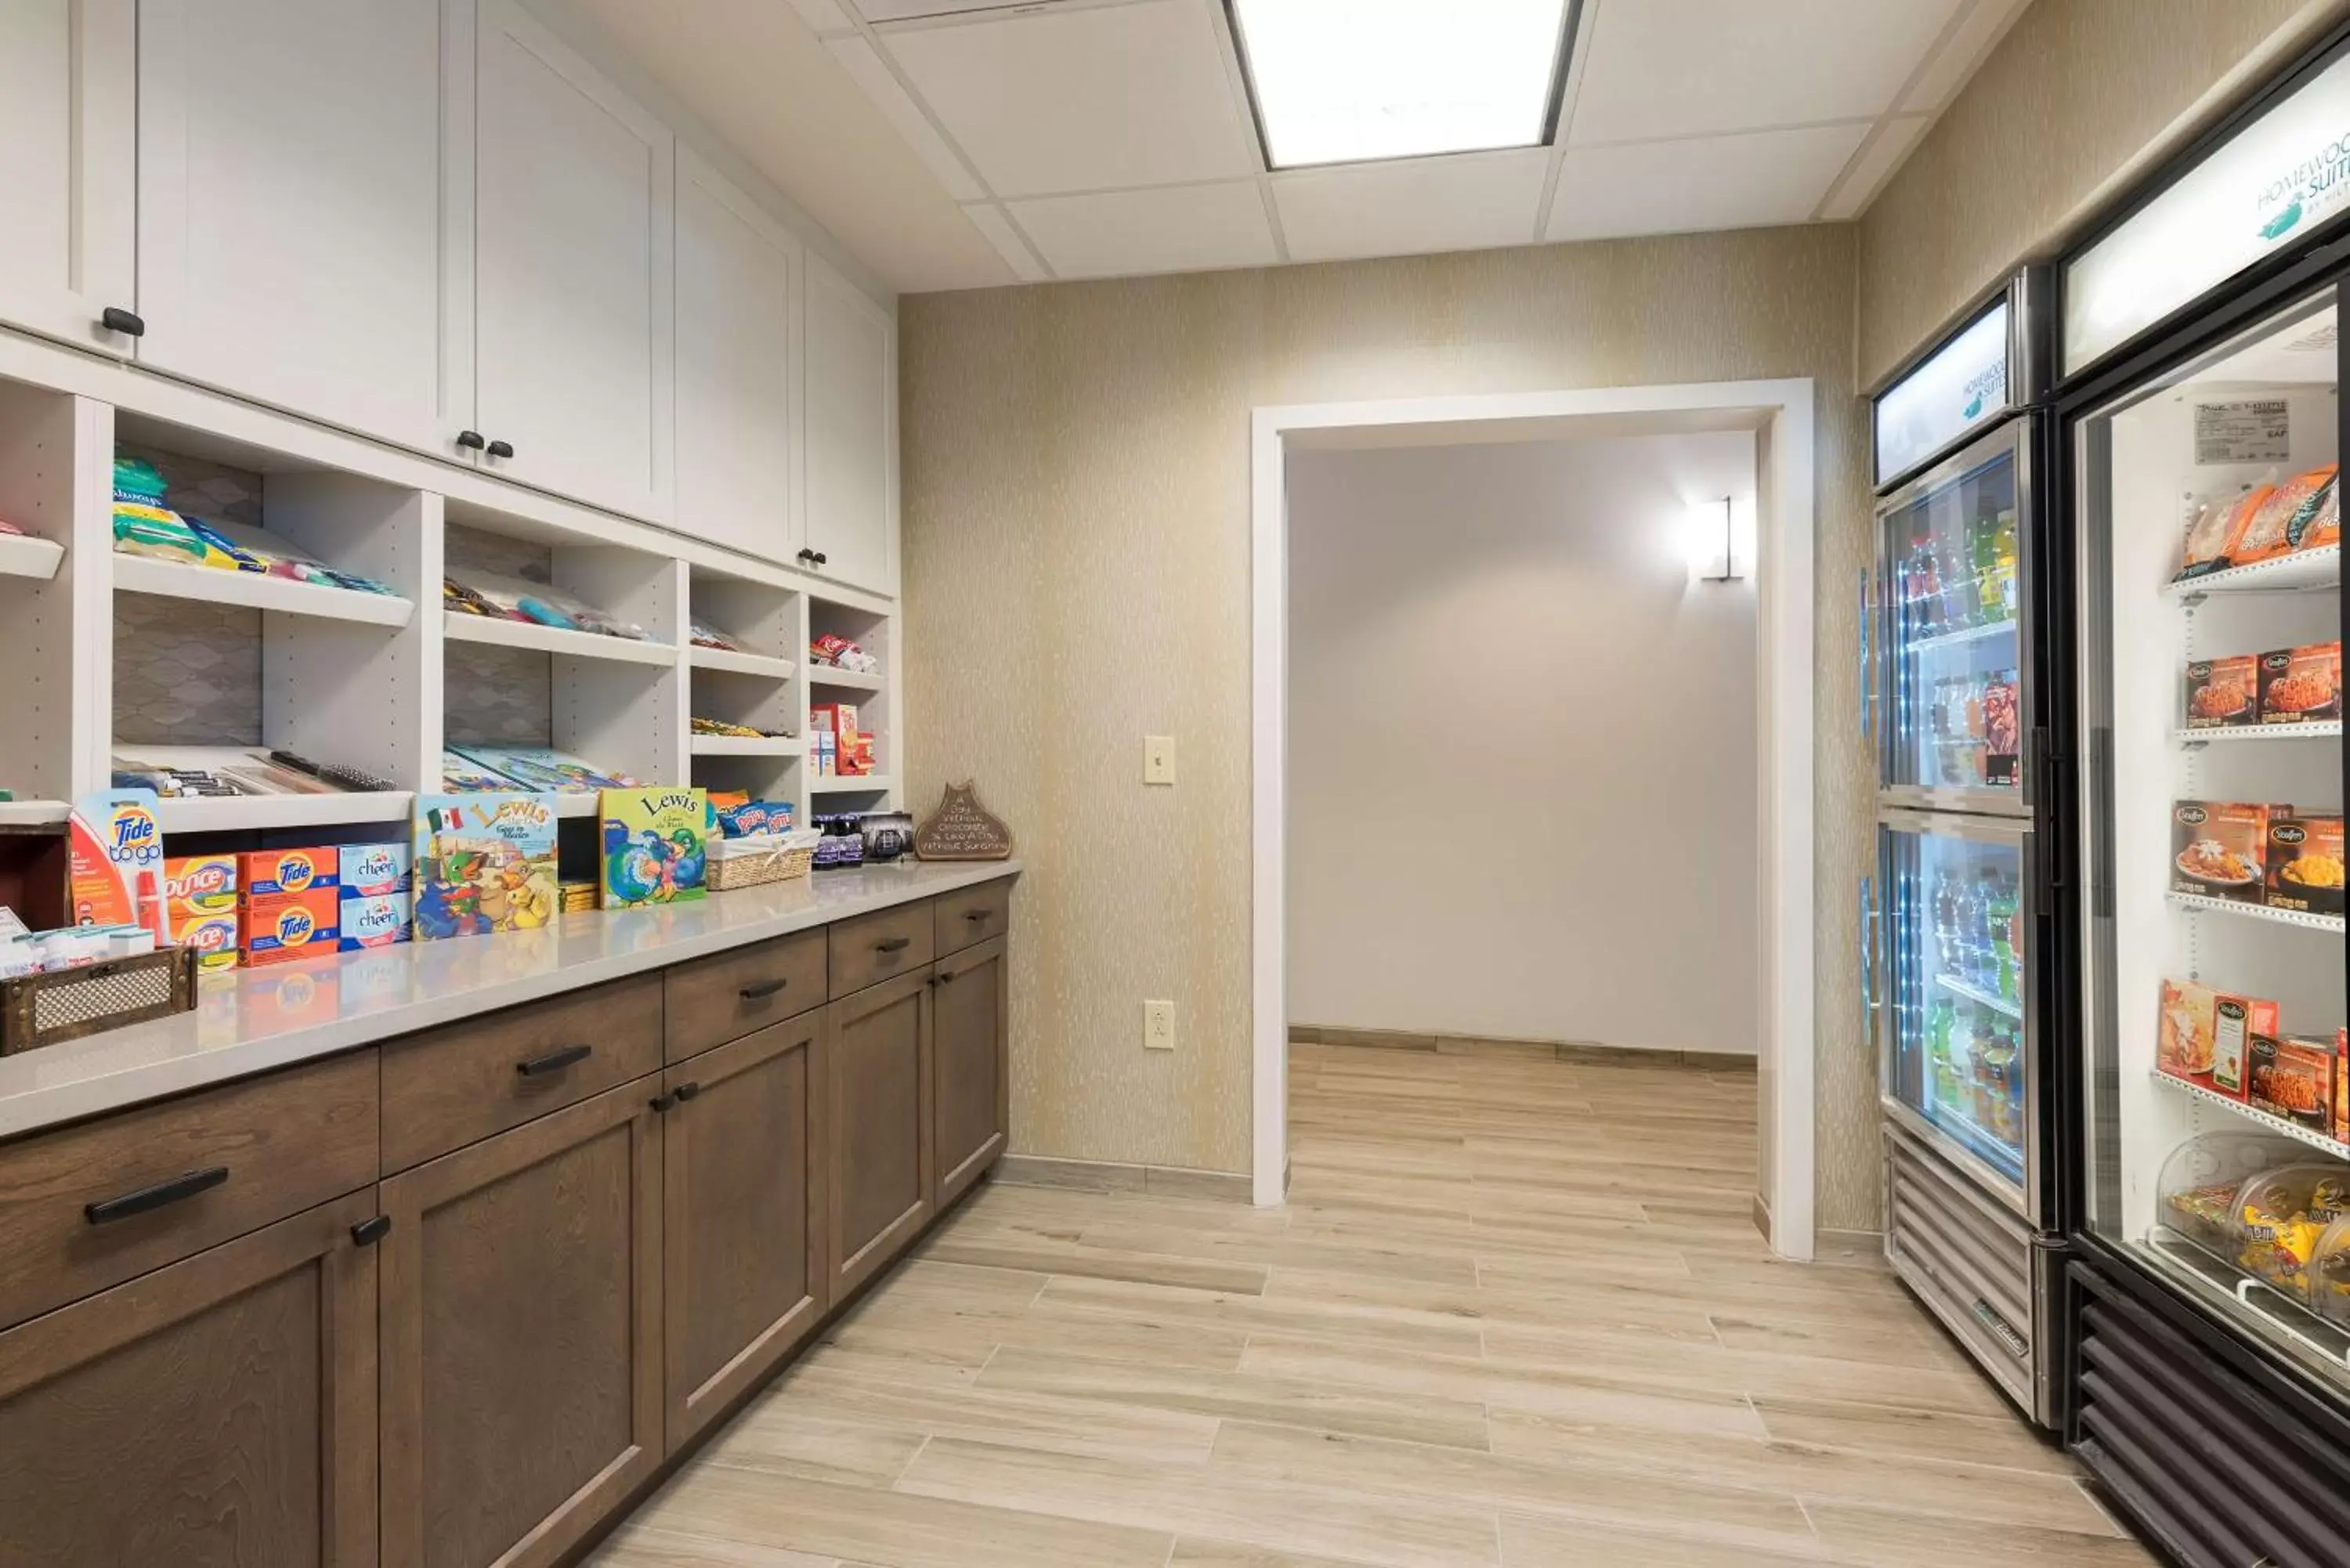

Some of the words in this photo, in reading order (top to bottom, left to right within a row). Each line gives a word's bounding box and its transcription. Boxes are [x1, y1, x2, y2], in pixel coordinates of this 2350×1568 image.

[2308, 156, 2350, 198] SUIT
[469, 797, 550, 829] Lewis
[640, 791, 698, 816] Lewis
[114, 818, 154, 846] Tide
[110, 845, 132, 862] to
[136, 845, 161, 865] go
[358, 858, 394, 876] cheer
[164, 870, 224, 898] ounce
[280, 862, 311, 885] Tide
[280, 916, 311, 940] Tide
[360, 910, 395, 927] cheer
